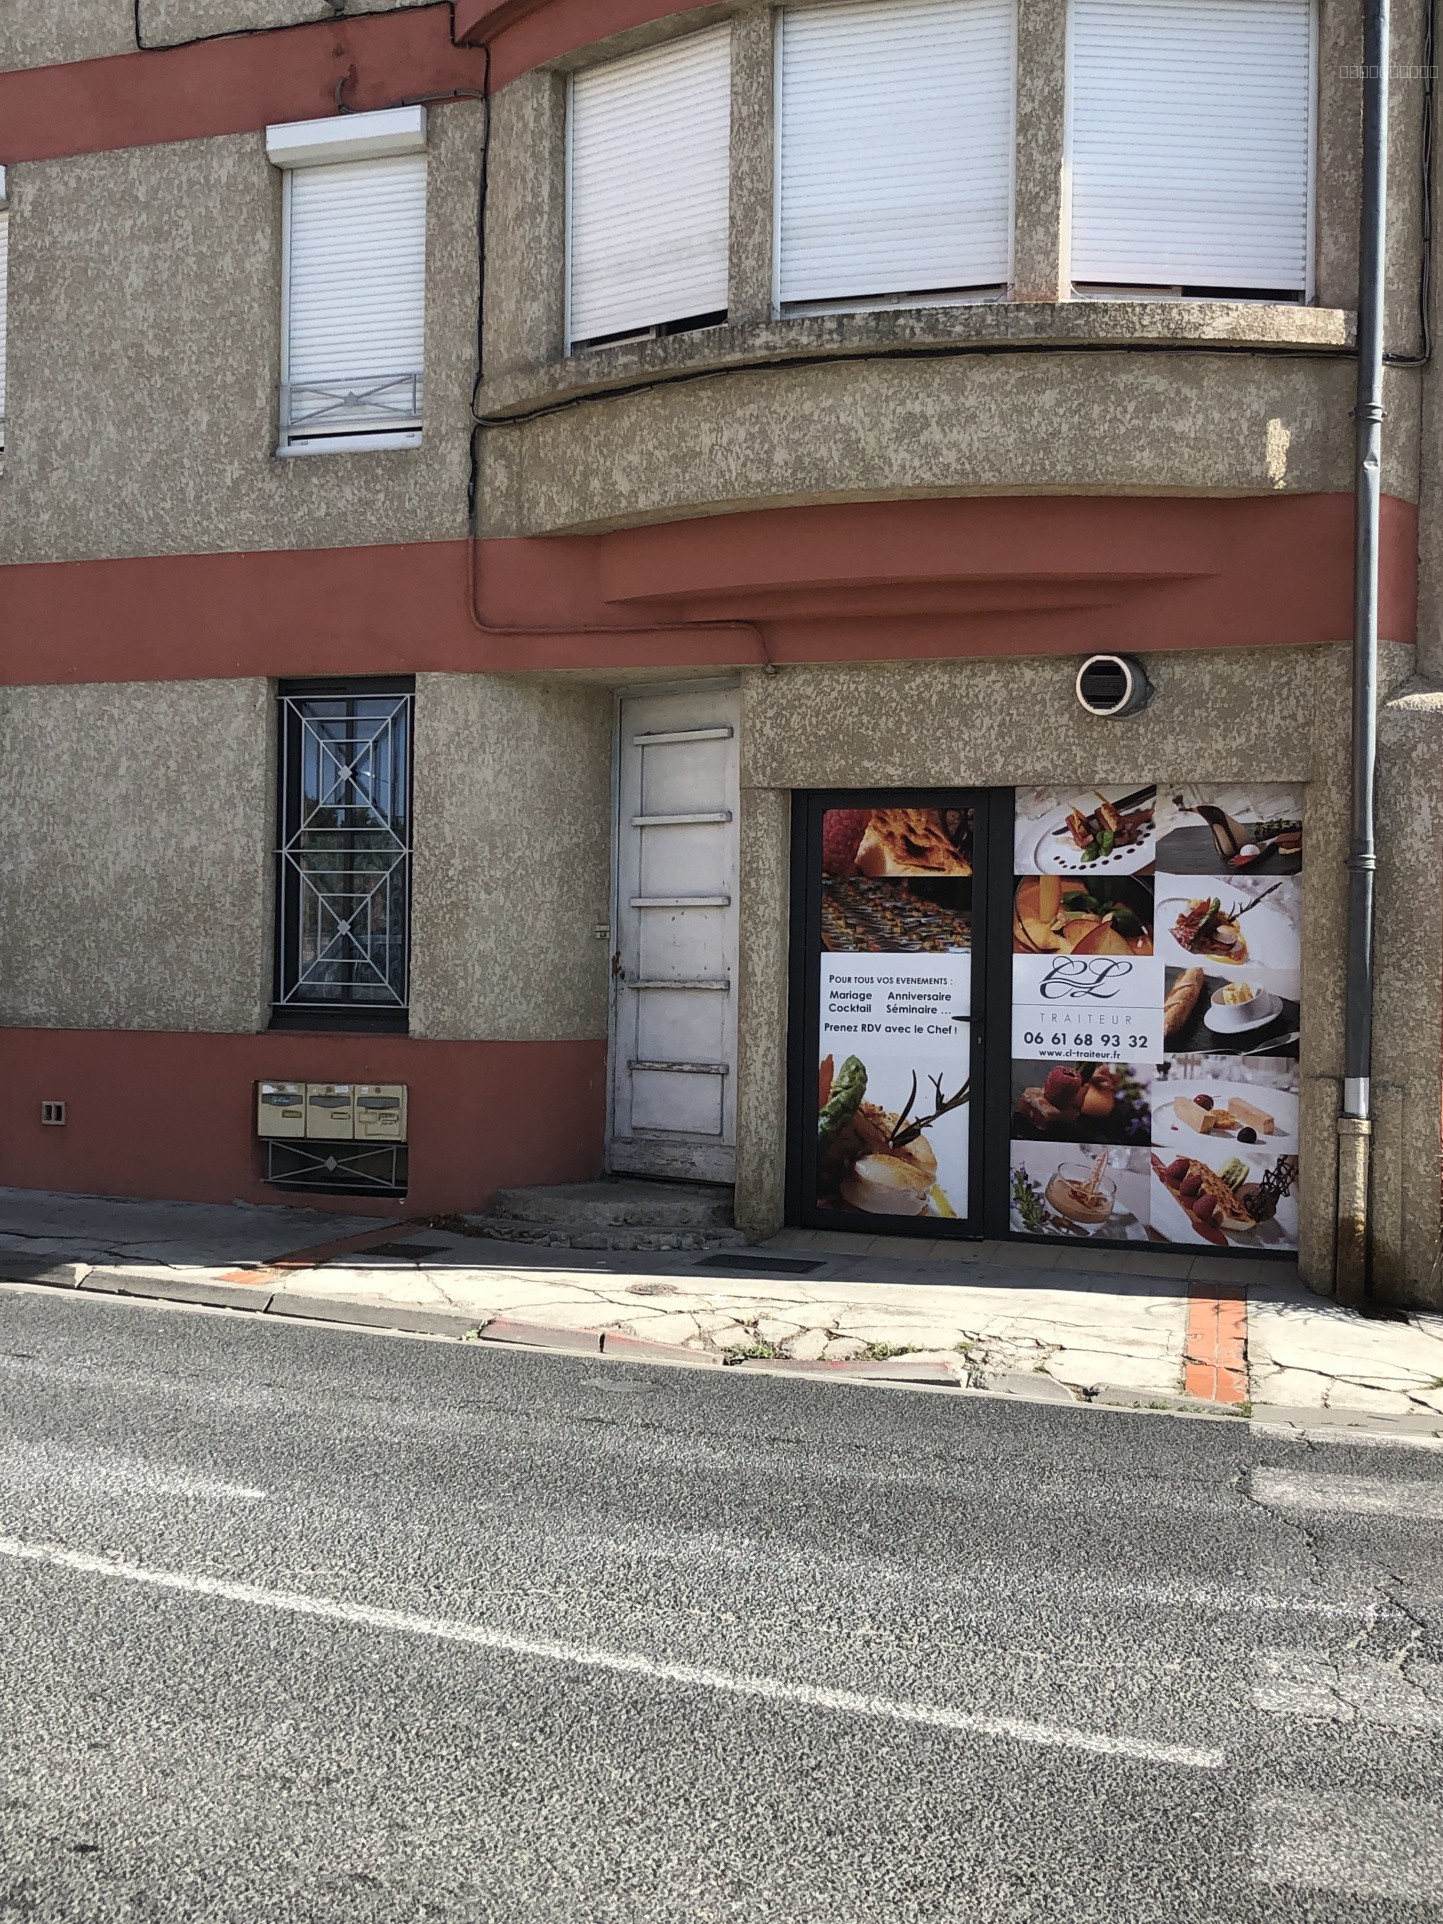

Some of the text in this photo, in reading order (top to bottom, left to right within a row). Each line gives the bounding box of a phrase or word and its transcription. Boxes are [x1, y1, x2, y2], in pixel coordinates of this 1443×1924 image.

[829, 991, 952, 1001] Mariage Anniversaire
[828, 1004, 872, 1013] Cocktail
[886, 1004, 938, 1014] Séminaire
[1040, 1013, 1132, 1025] TRAITEUR
[824, 1023, 858, 1032] Prenez
[861, 1024, 882, 1032] RDV
[884, 1026, 911, 1034] avec
[914, 1024, 923, 1034] le
[927, 1025, 952, 1034] Chef
[1024, 1032, 1148, 1048] 06 61 68 93 32
[1039, 1049, 1121, 1059] www.cl-traiteur.fr
